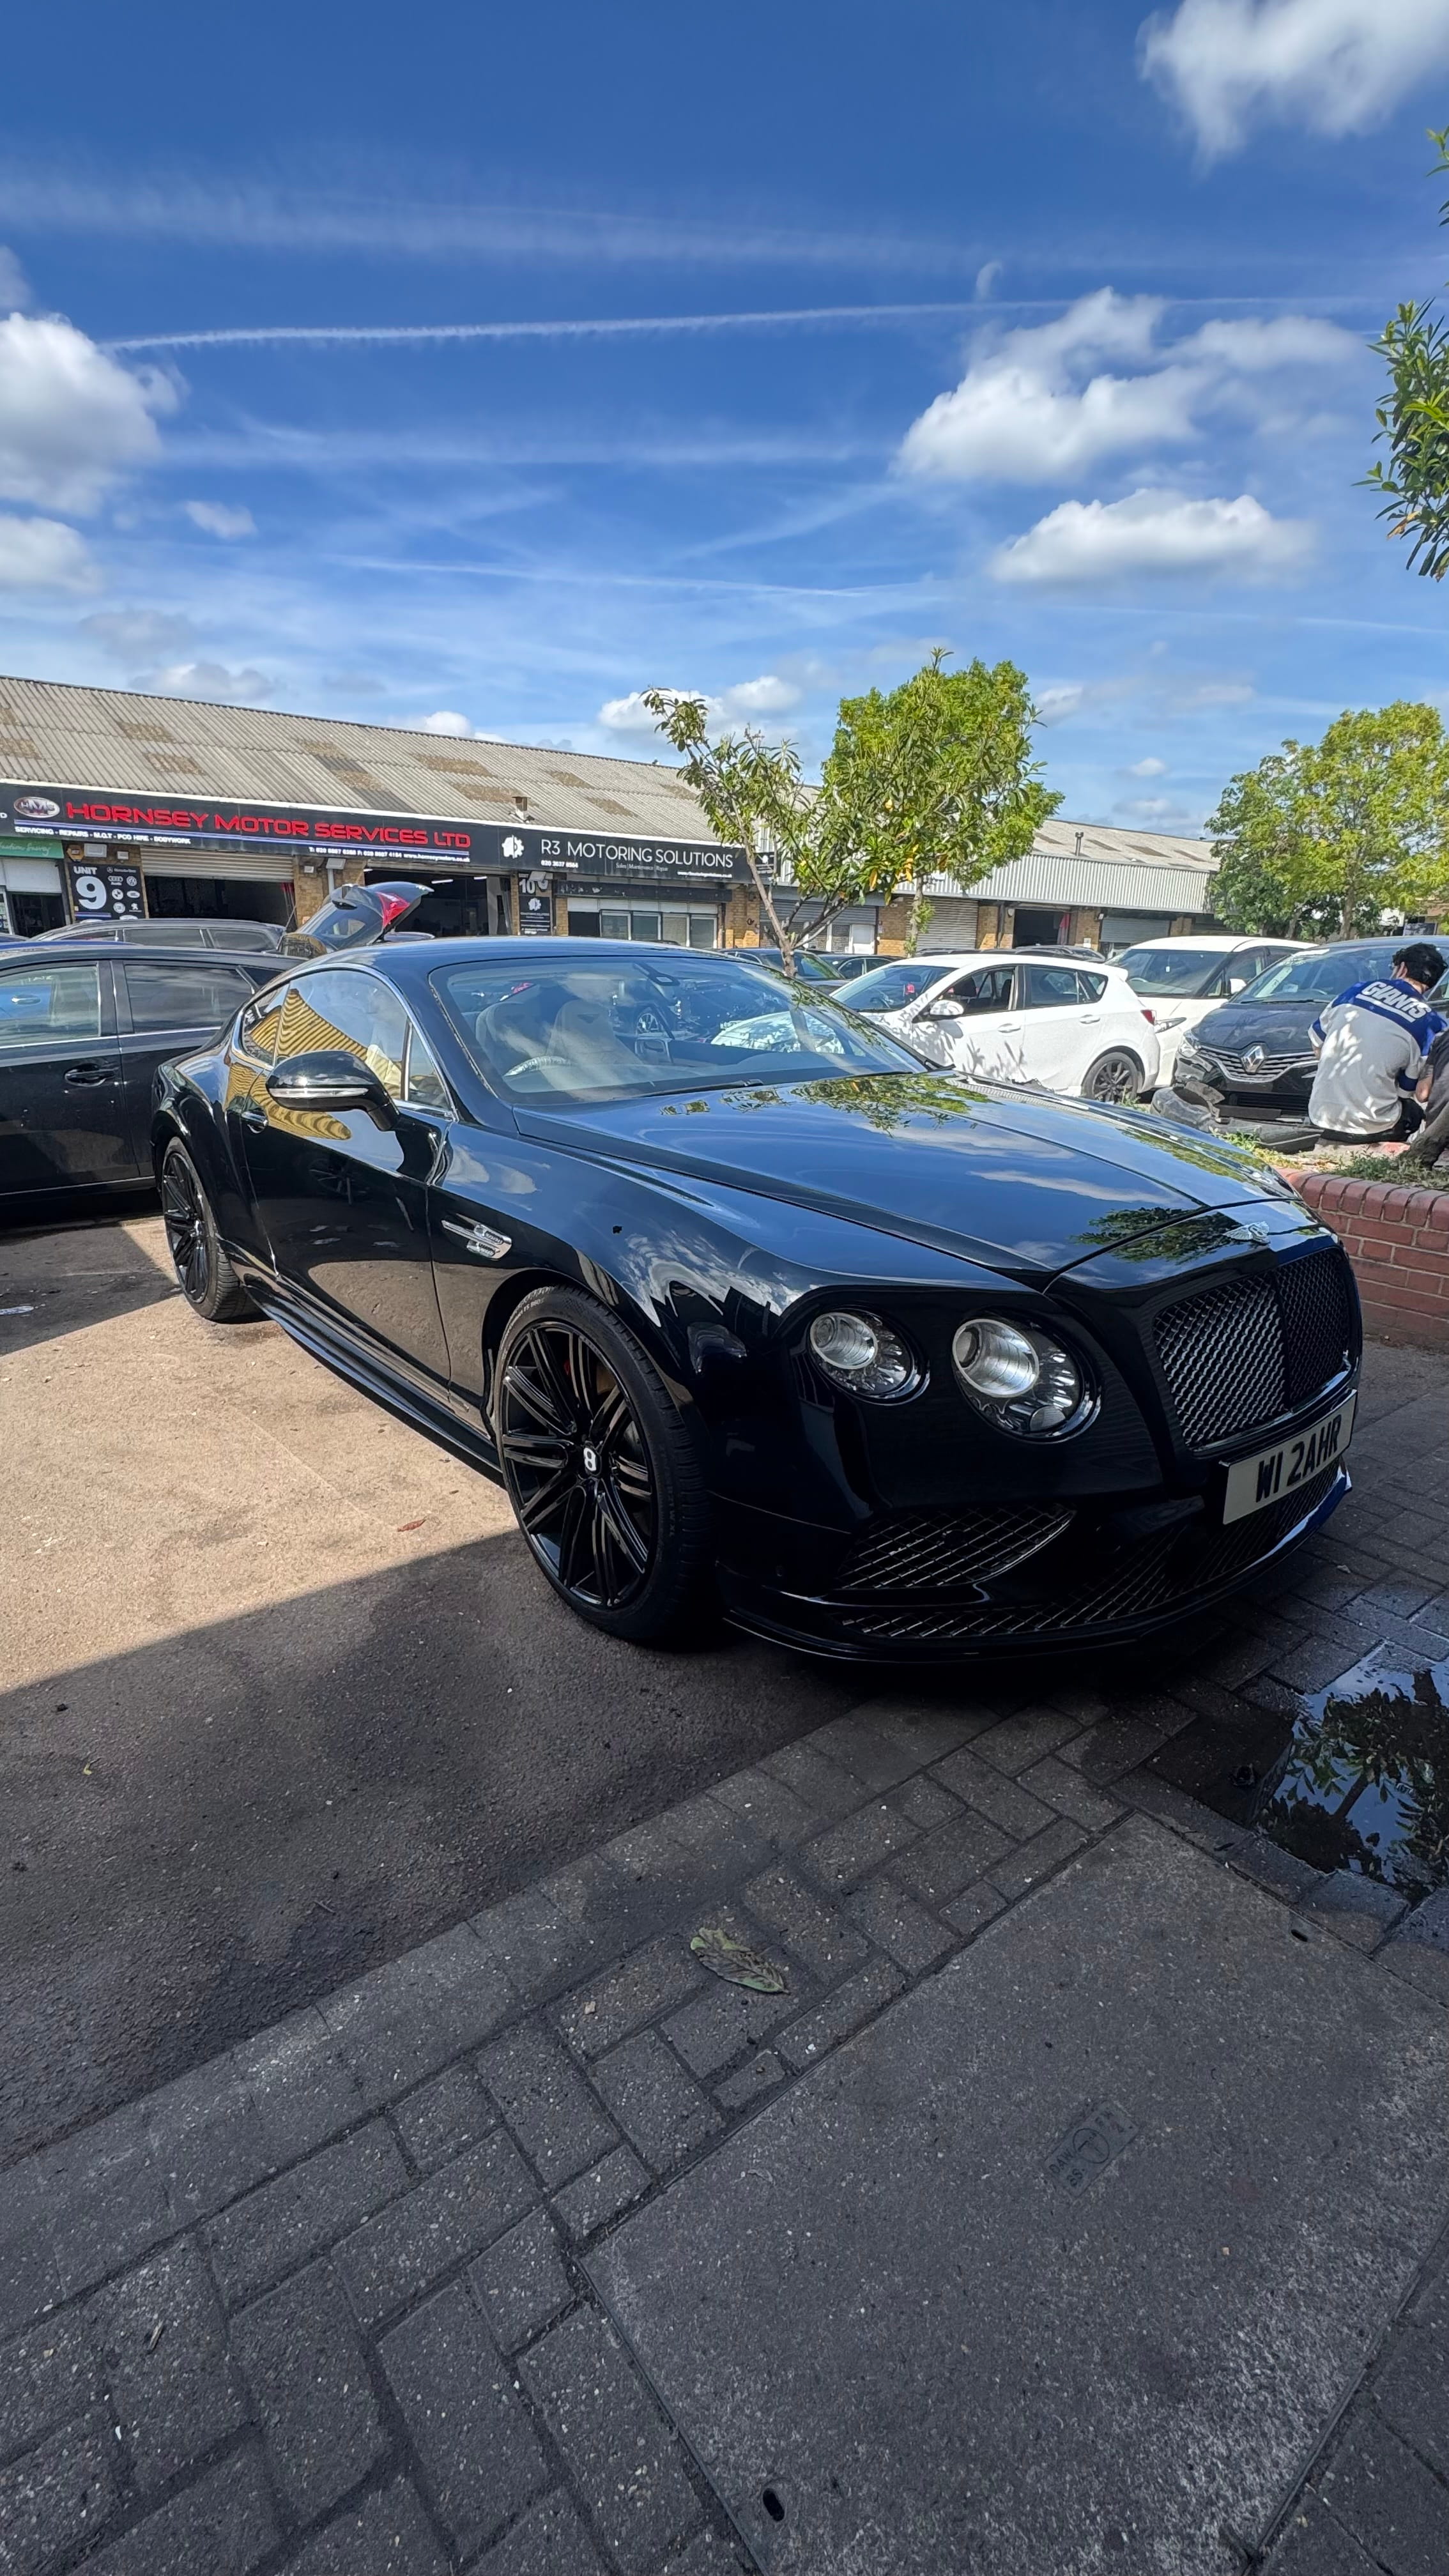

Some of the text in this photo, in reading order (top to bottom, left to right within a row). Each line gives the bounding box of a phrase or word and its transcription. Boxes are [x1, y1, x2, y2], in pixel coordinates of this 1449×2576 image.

[15, 826, 54, 835] SERVICING
[59, 829, 89, 838] REPAIRS
[153, 836, 191, 845] BODYWORK
[66, 802, 471, 848] HORNSEY MOTOR SERVICES LTD
[540, 839, 733, 868] R3 MOTORING SOLUTIONS
[73, 866, 97, 875] UNIT
[75, 876, 107, 910] 9
[1361, 981, 1432, 1018] GIANTS
